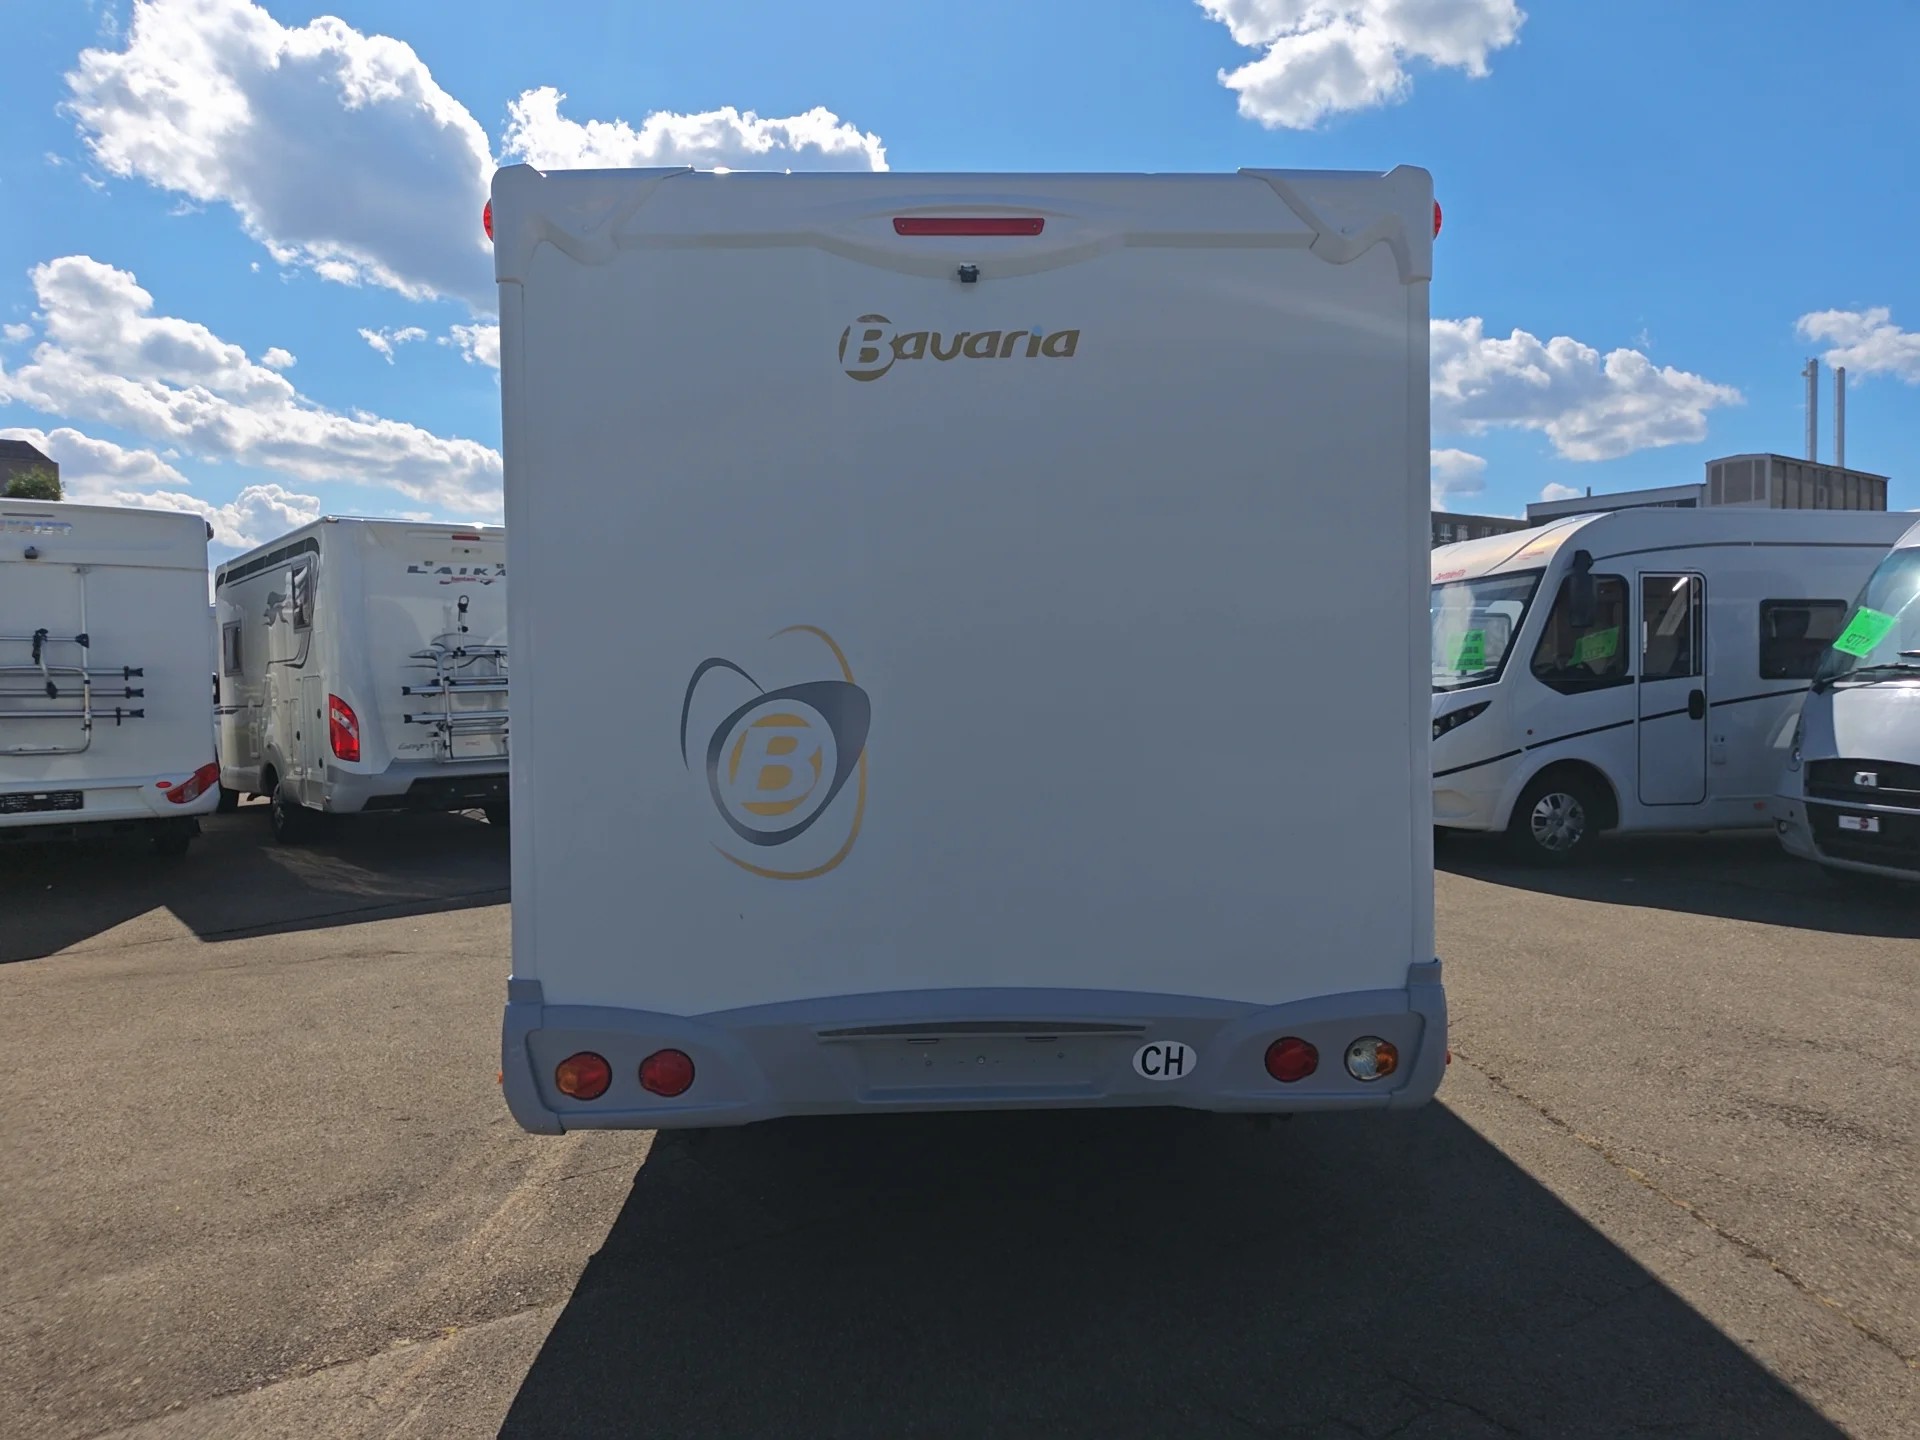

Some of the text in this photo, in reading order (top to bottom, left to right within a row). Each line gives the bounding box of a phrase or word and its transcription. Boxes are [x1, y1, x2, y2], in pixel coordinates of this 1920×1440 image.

[838, 313, 1081, 382] Bavaria
[407, 565, 507, 577] LAIKA
[731, 717, 820, 811] B
[1141, 1045, 1184, 1076] CH
